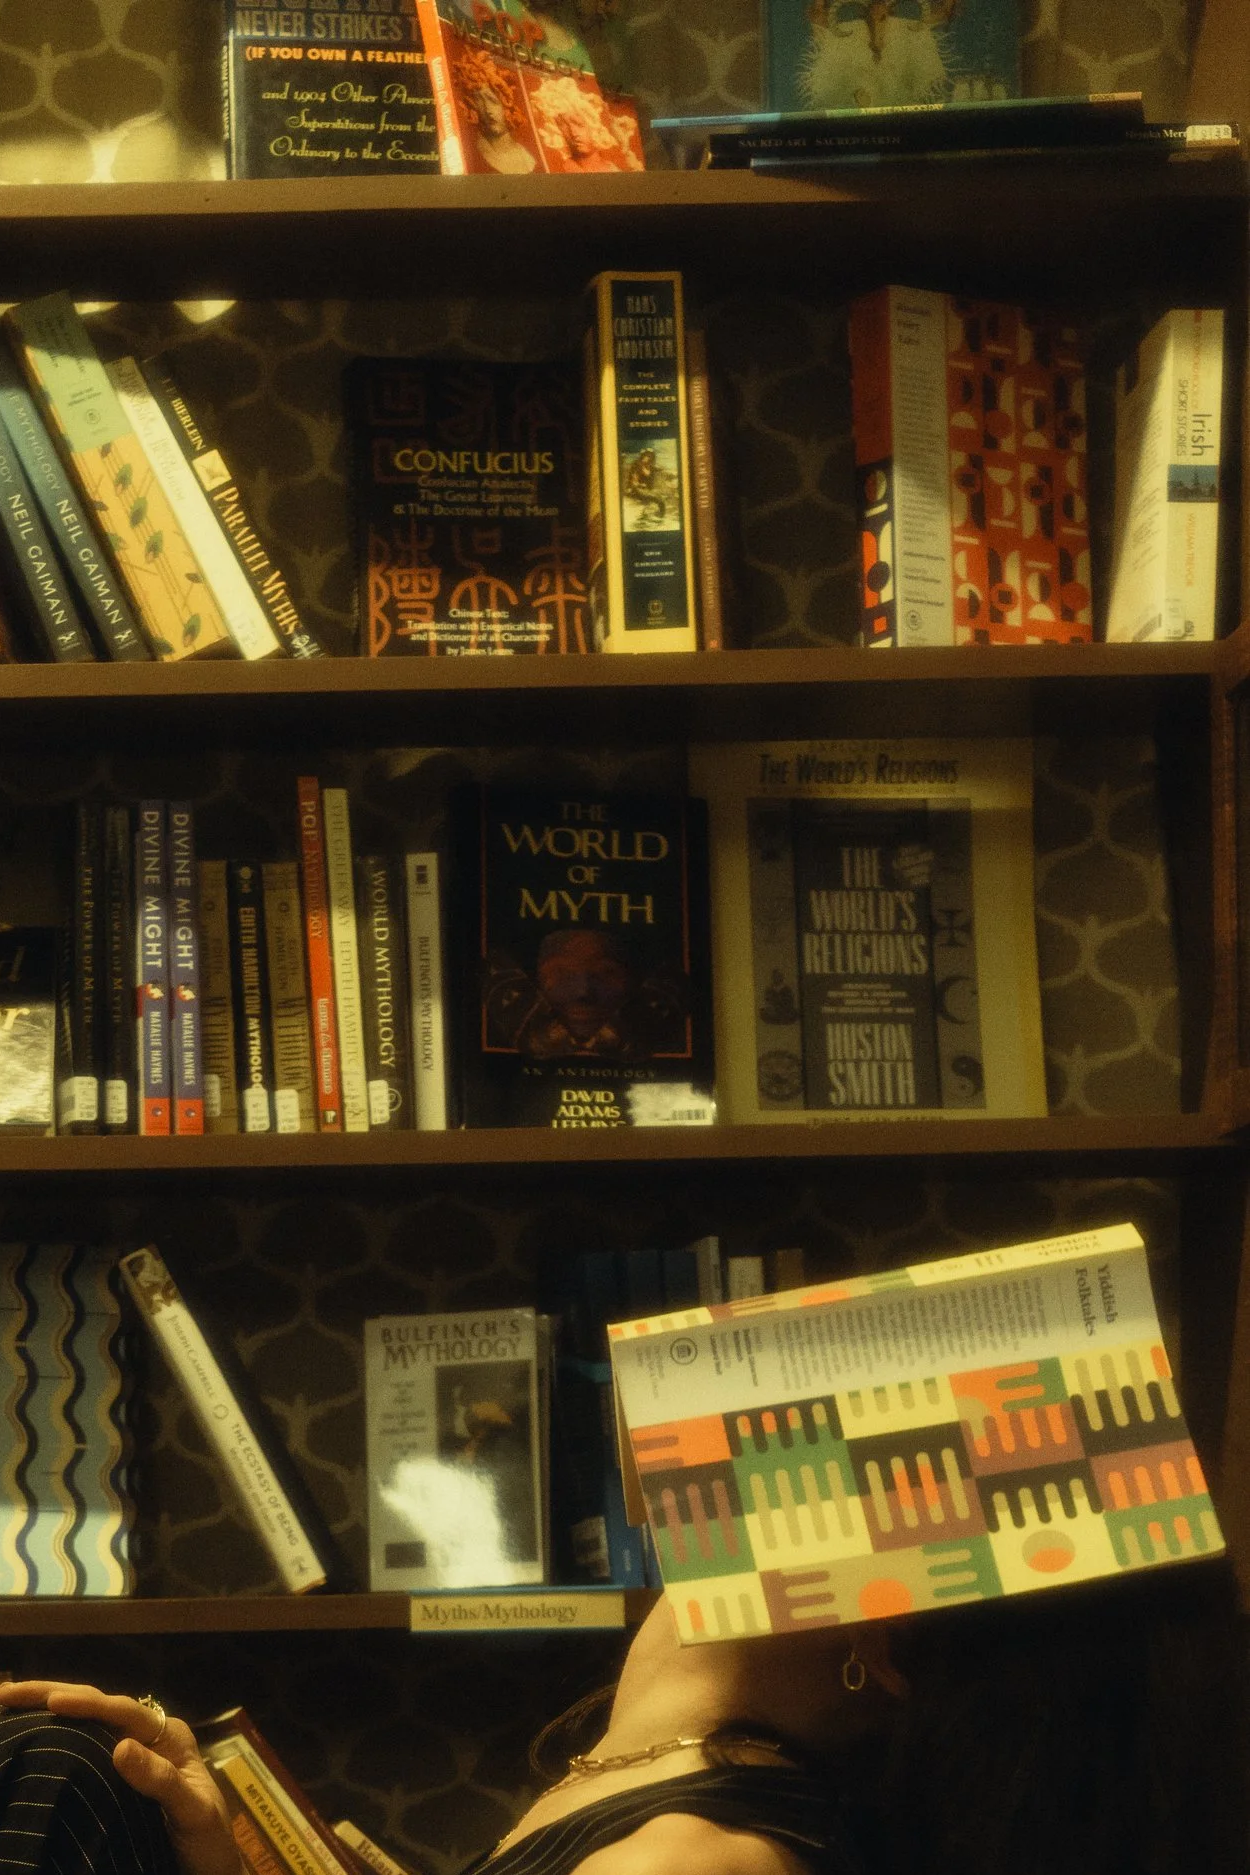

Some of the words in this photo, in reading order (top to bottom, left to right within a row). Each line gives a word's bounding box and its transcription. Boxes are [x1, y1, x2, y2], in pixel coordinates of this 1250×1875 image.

[234, 11, 309, 38] NEVER
[313, 15, 404, 41] STRIKES
[286, 110, 375, 133] Superstitions
[379, 110, 412, 134] from
[416, 110, 435, 133] the
[614, 316, 675, 337] CHRISTIAN
[1192, 413, 1212, 458] Irish
[394, 448, 554, 474] CONFUCIUS
[7, 493, 33, 540] NEIL
[26, 545, 69, 626] GAIMAN
[56, 498, 88, 544] NEIL
[75, 546, 124, 626] GAIMAN
[210, 487, 268, 572] PARALLEL
[256, 570, 302, 635] MYTHS
[558, 801, 611, 821] THE
[143, 811, 161, 885] DIVINE
[172, 812, 192, 887] DIVINE
[500, 822, 670, 861] WORLD
[566, 864, 602, 885] OF
[840, 846, 885, 889] THE
[370, 869, 390, 941] WORLD
[518, 888, 656, 926] MYTH
[144, 896, 163, 969] MIGHT
[175, 898, 194, 970] MIGHT
[803, 931, 928, 975] RELIGIONS
[373, 946, 396, 1069] MYTHOLOGY
[150, 1011, 163, 1047] NATALIE
[182, 1012, 195, 1048] NATALIE
[825, 1022, 915, 1061] HUSTON
[150, 1050, 164, 1085] HAYNES
[183, 1051, 196, 1086] HAYNES
[829, 1060, 916, 1106] SMITH
[555, 1104, 621, 1119] ADAMS
[561, 1089, 615, 1105] DAVID
[1075, 1265, 1100, 1338] Folktales
[1097, 1262, 1119, 1325] Yiddish
[383, 1337, 521, 1372] MYTHOLOGY
[231, 1422, 248, 1445] THE
[241, 1445, 273, 1496] ECSTASY
[266, 1496, 281, 1511] OF
[276, 1512, 299, 1547] BEING
[421, 1602, 578, 1626] Myths/Mythology
[245, 1783, 291, 1844] MITAKUYE
